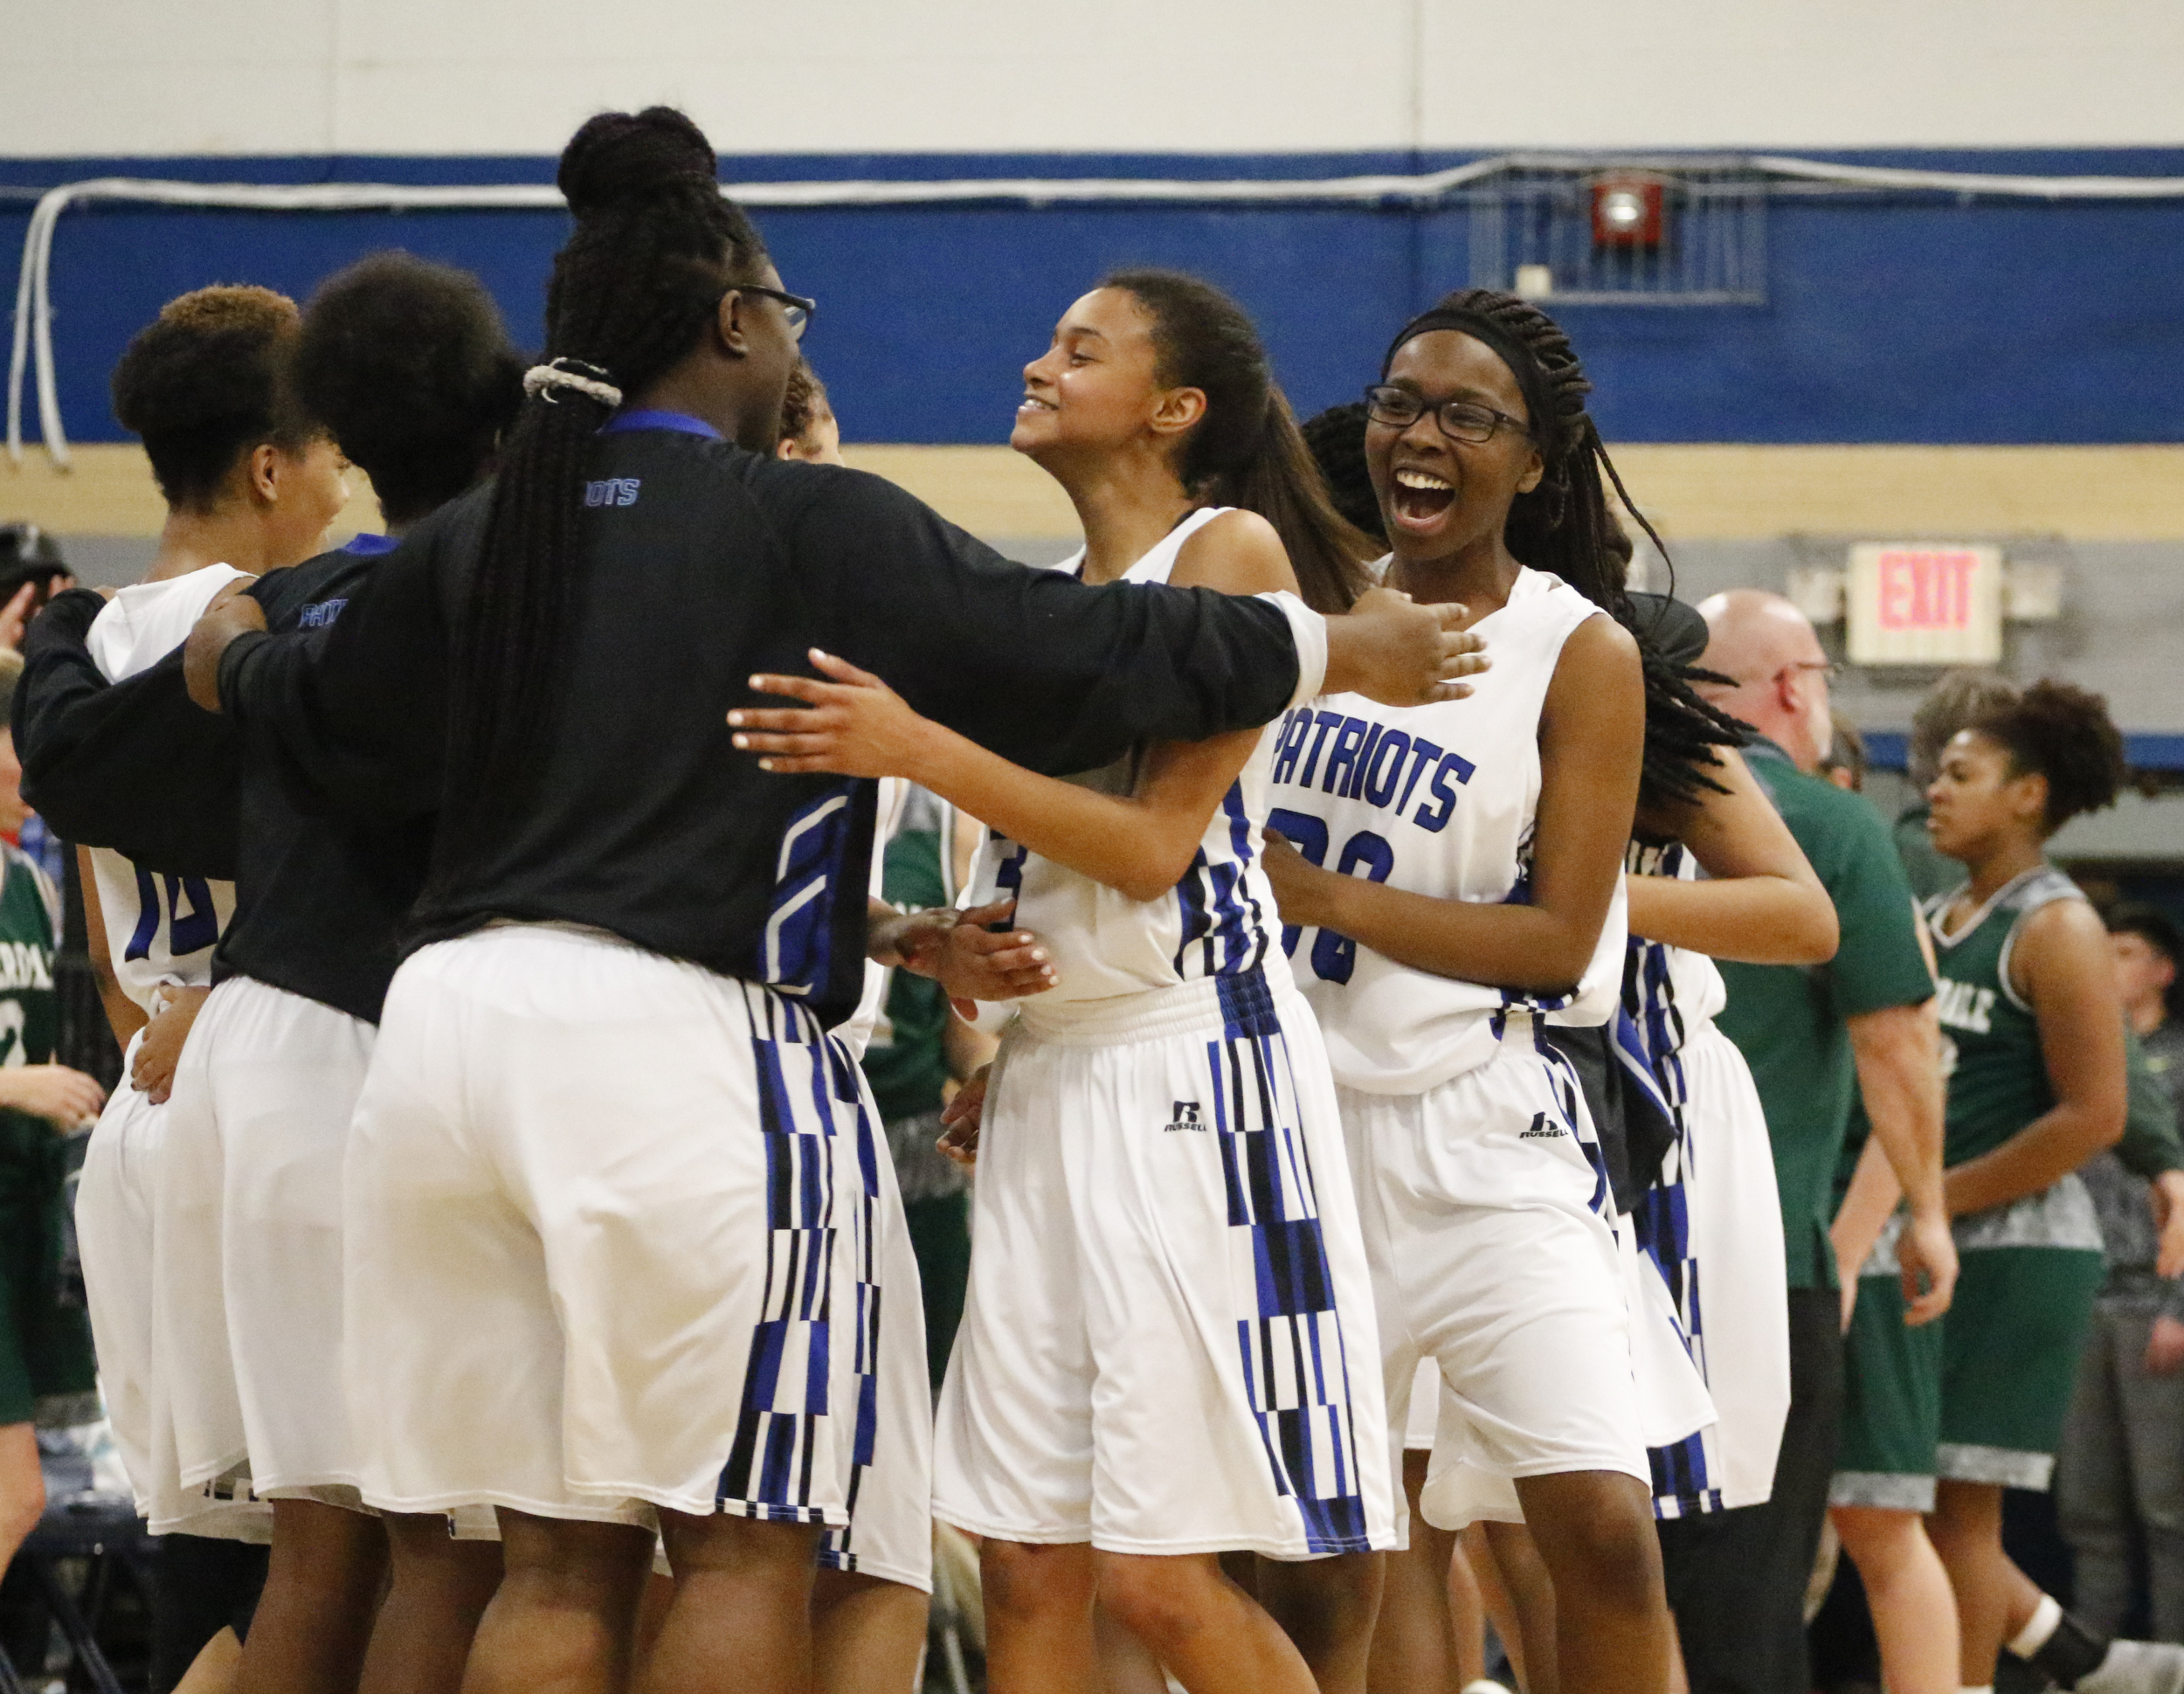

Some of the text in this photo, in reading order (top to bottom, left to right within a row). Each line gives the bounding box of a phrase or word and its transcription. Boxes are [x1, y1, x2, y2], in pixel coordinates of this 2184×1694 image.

[1879, 550, 1980, 631] EXIT
[1270, 707, 1476, 833] PATRIOTS
[1164, 1122, 1207, 1132] RUSSELL
[1519, 1129, 1569, 1139] RUSSELL
